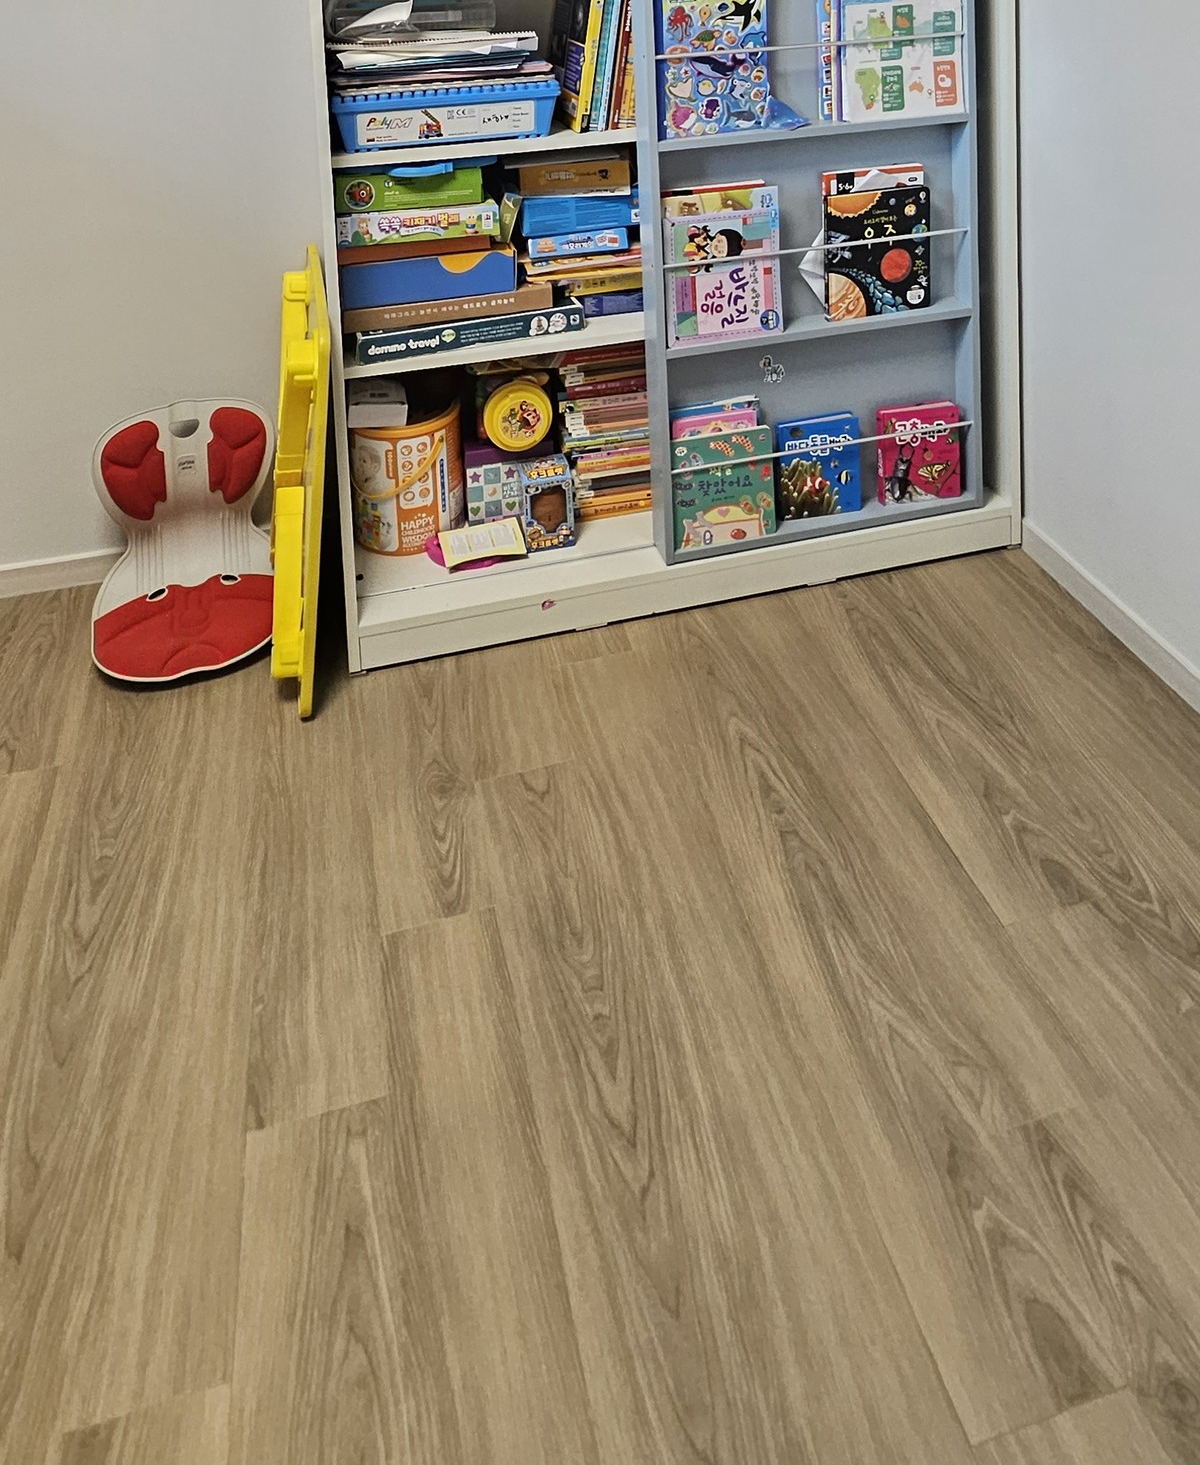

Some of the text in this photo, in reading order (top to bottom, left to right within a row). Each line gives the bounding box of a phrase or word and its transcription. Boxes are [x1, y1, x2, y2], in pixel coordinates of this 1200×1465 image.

[402, 217, 437, 228] 키재기
[700, 280, 725, 315] 걸음
[721, 267, 750, 329] 바느질
[367, 343, 407, 356] domino
[698, 475, 753, 497] 찾았어요
[400, 515, 434, 531] HAPPY
